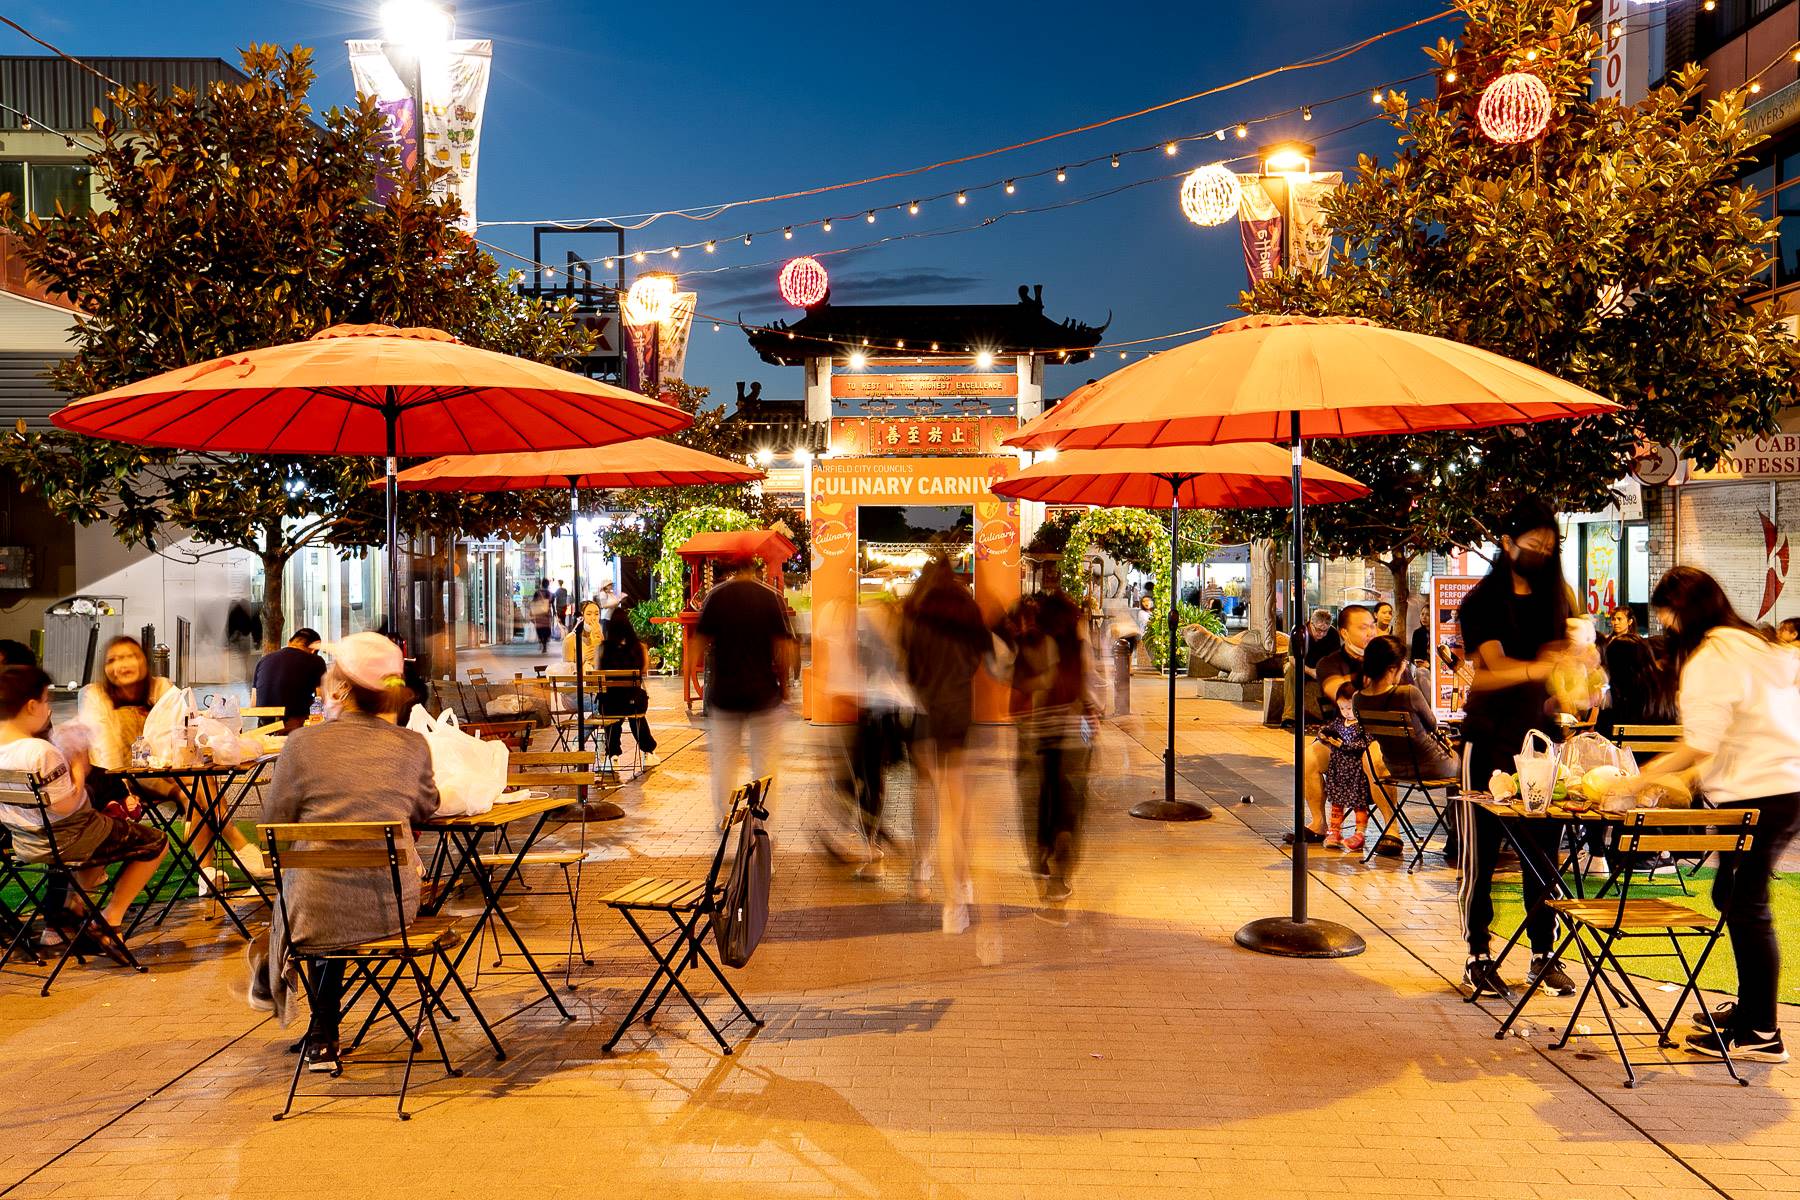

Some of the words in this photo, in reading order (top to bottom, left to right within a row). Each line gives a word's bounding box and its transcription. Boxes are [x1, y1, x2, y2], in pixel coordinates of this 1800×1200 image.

[863, 382, 881, 391] REST
[900, 382, 914, 391] THE
[956, 381, 1003, 390] EXCELLENCE
[812, 464, 854, 473] FAIRFIELD
[855, 464, 871, 473] CITY
[873, 464, 913, 473] COUNCIL'S
[1716, 457, 1800, 474] ROFESS
[813, 476, 914, 495] CULINARY
[815, 531, 852, 545] Culinary
[978, 529, 1016, 544] Culinary
